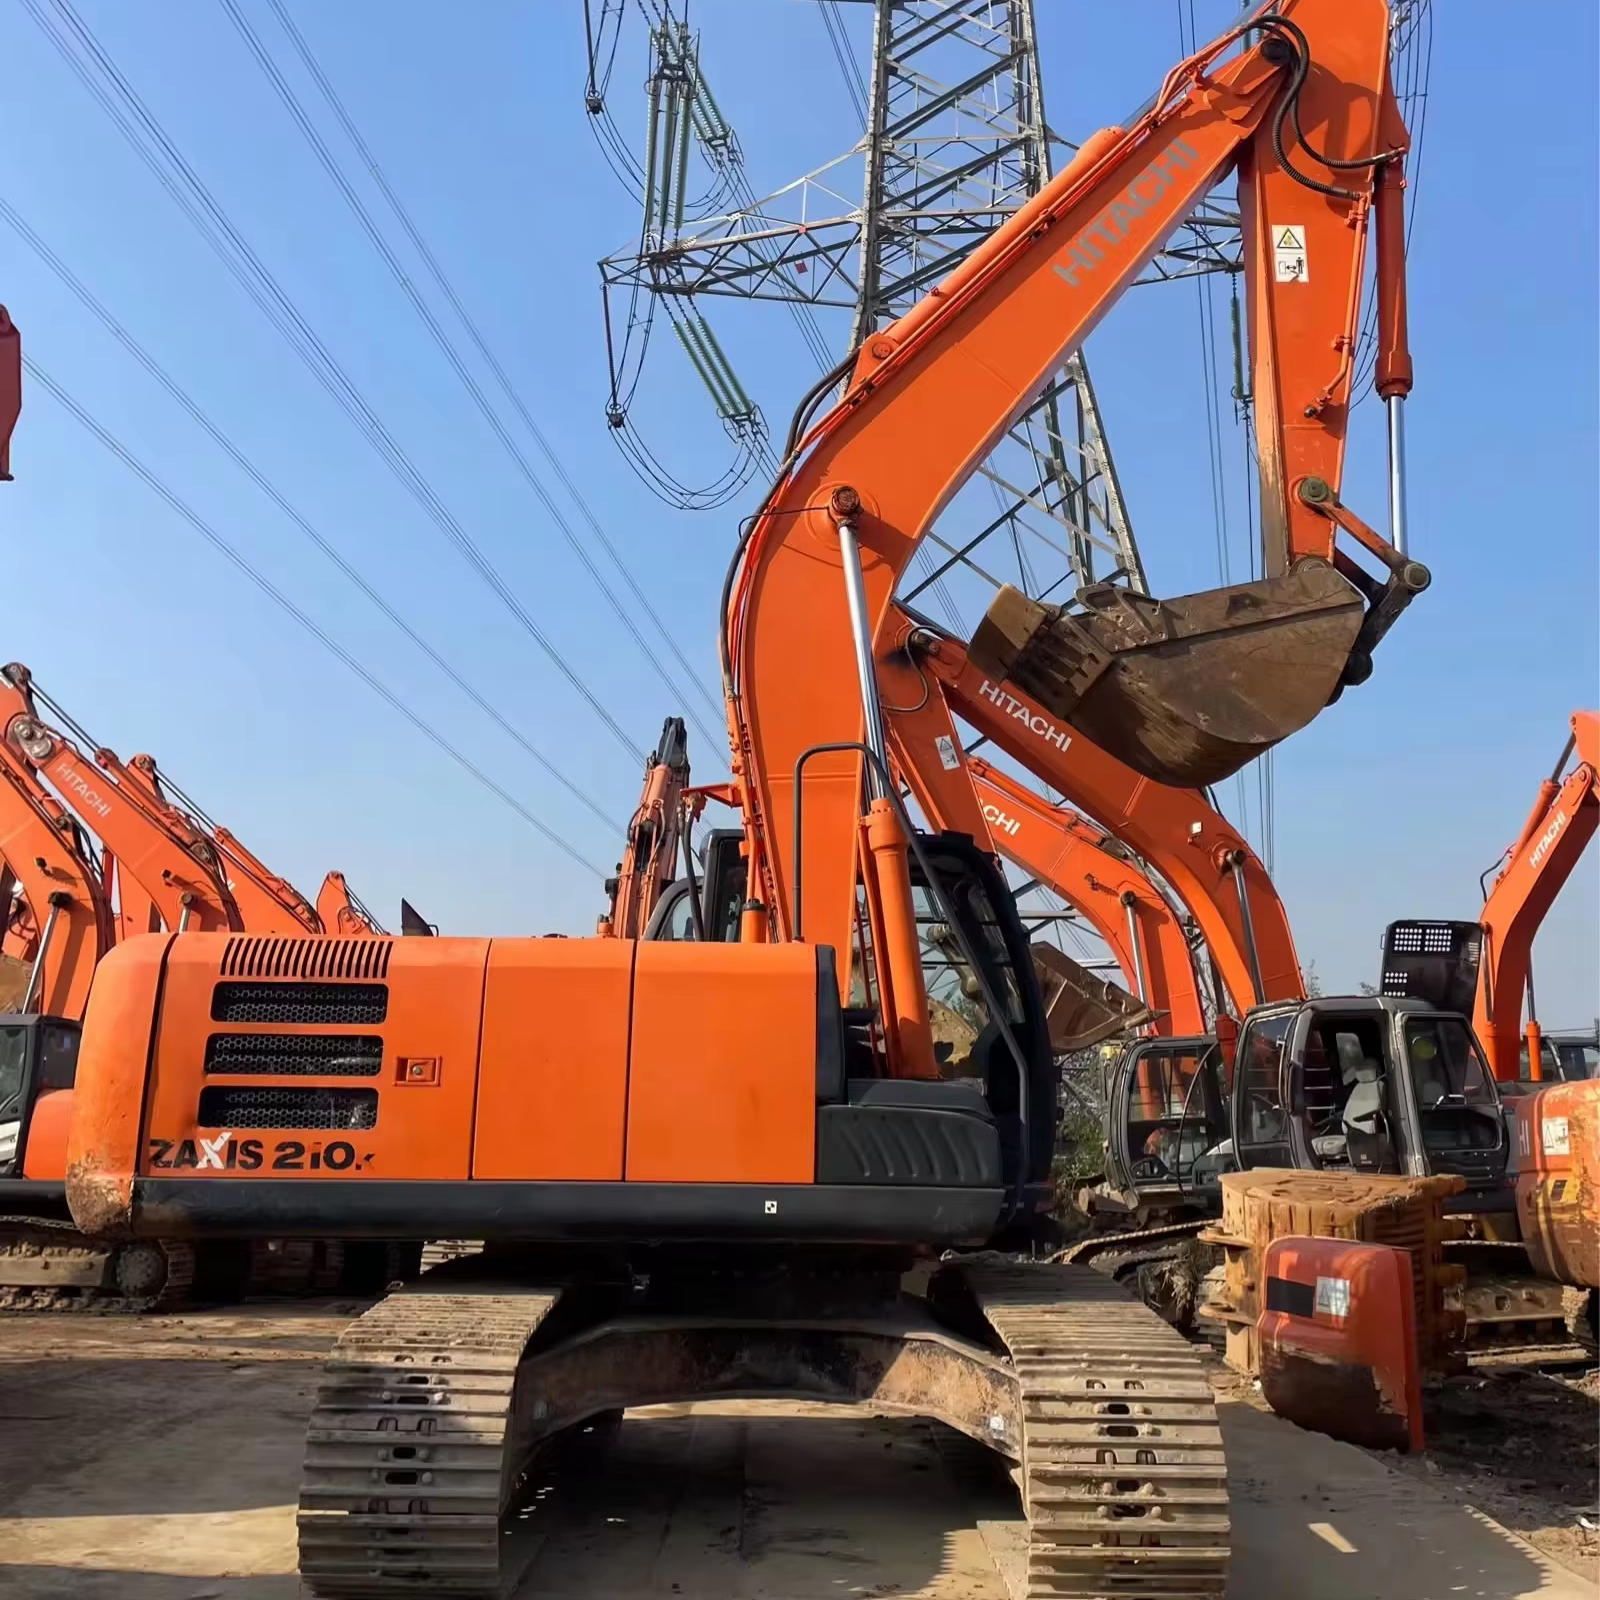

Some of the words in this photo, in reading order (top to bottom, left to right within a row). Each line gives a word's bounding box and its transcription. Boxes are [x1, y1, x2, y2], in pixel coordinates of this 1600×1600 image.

[1052, 137, 1197, 287] HITACHI
[978, 679, 1072, 753] HITACHI
[56, 763, 112, 818] HITACHI
[979, 798, 1021, 836] CHI
[1529, 809, 1567, 870] HITACHI
[148, 1131, 264, 1170] ZAXIS
